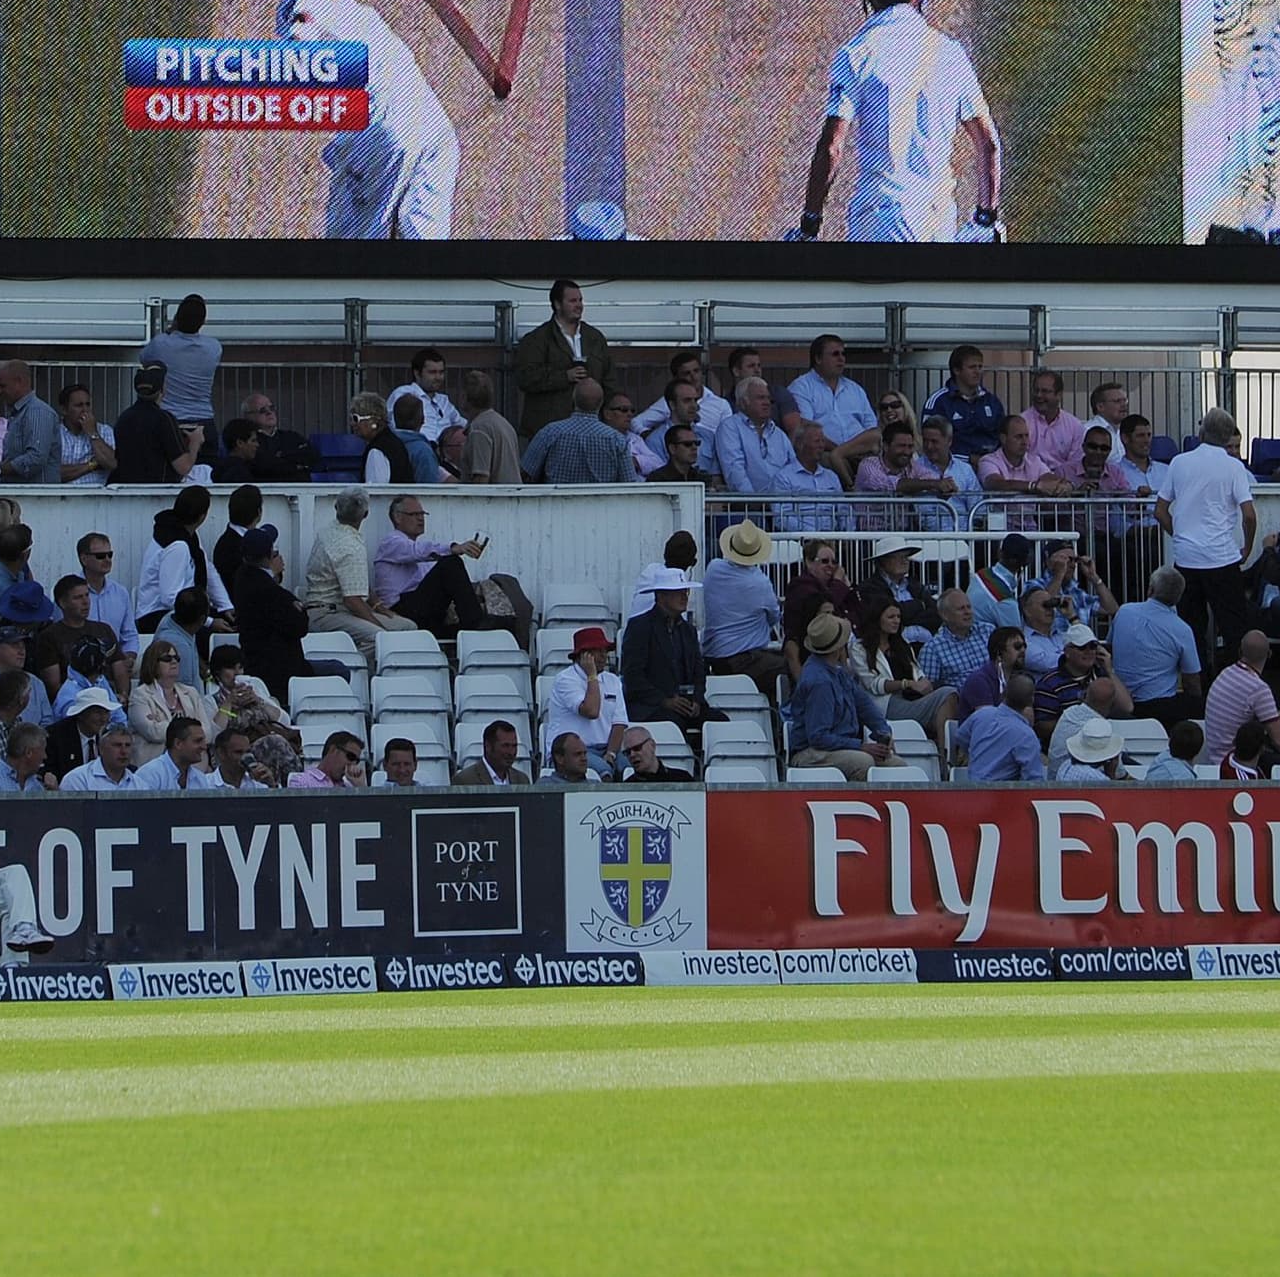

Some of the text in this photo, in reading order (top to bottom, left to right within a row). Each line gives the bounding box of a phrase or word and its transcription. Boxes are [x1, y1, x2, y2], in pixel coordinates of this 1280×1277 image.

[156, 46, 338, 84] PITCHING
[146, 89, 347, 124] OUTSIDE OFF
[606, 804, 665, 824] DURHAM
[434, 840, 499, 864] PORT
[38, 827, 140, 937] OF
[171, 822, 385, 932] TYNE
[461, 864, 474, 878] of
[806, 800, 1001, 943] Fly
[435, 881, 499, 903] TYNE
[7, 965, 105, 1001] Investec
[138, 963, 236, 998] Investec
[271, 959, 371, 994] Investec
[407, 954, 503, 989] Investec
[534, 952, 636, 986] Investec
